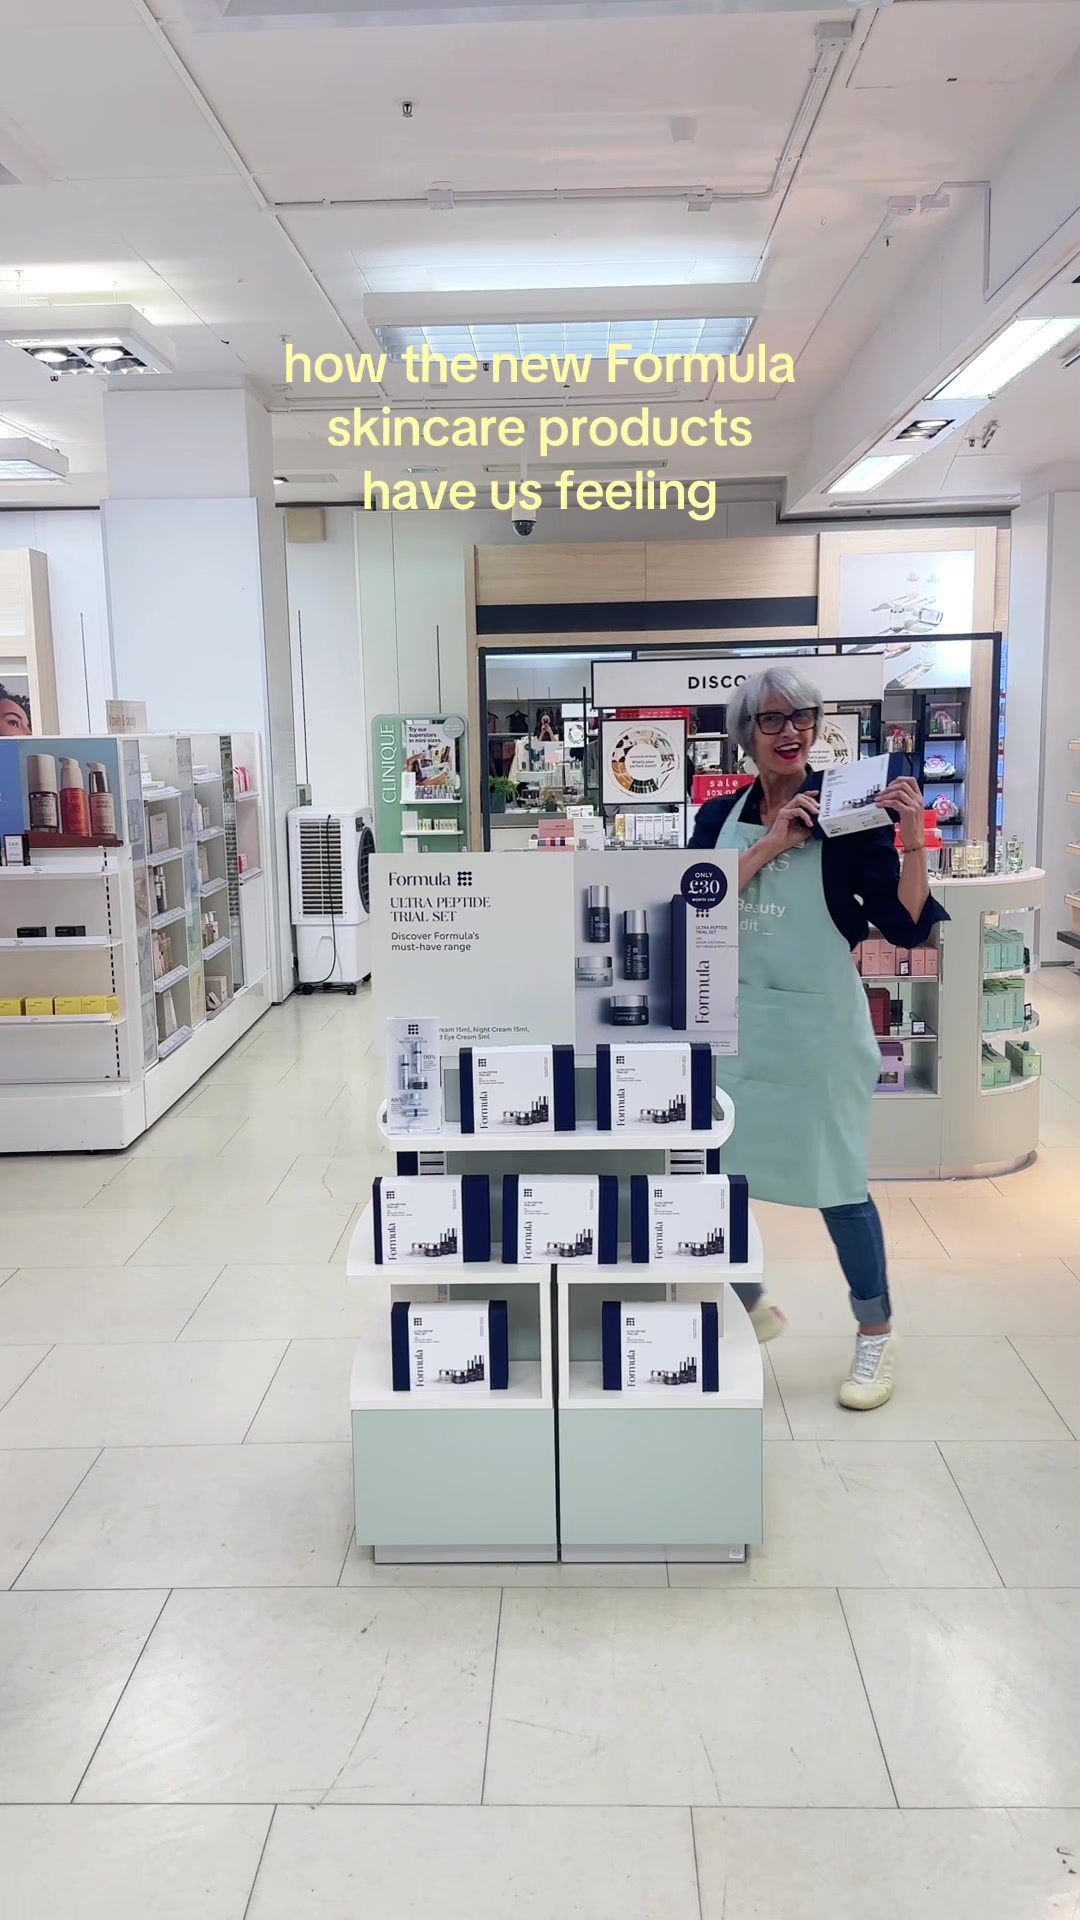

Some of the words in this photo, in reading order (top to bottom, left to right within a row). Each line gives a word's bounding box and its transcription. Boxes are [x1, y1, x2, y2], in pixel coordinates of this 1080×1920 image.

[688, 675, 747, 689] DISCO
[380, 724, 398, 804] CLINIQUE
[709, 778, 738, 788] sale
[388, 872, 451, 886] Formula
[688, 880, 720, 894] £30
[390, 897, 433, 908] ULTRA
[436, 897, 491, 908] PEPTIDE
[738, 898, 786, 918] Beauty
[390, 911, 429, 922] TRIAL
[432, 911, 457, 922] SET
[740, 919, 758, 932] dit
[391, 932, 432, 940] Discover
[434, 931, 480, 940] Formula's
[391, 943, 442, 951] must-have
[444, 944, 471, 952] range
[695, 960, 710, 1024] Formula
[480, 1091, 488, 1129] Formula
[617, 1088, 625, 1126] Formula
[388, 1222, 397, 1260] Formula
[523, 1221, 532, 1259] Formula
[654, 1221, 663, 1259] Formula
[415, 1350, 424, 1387] Formula
[627, 1350, 636, 1387] Formula
